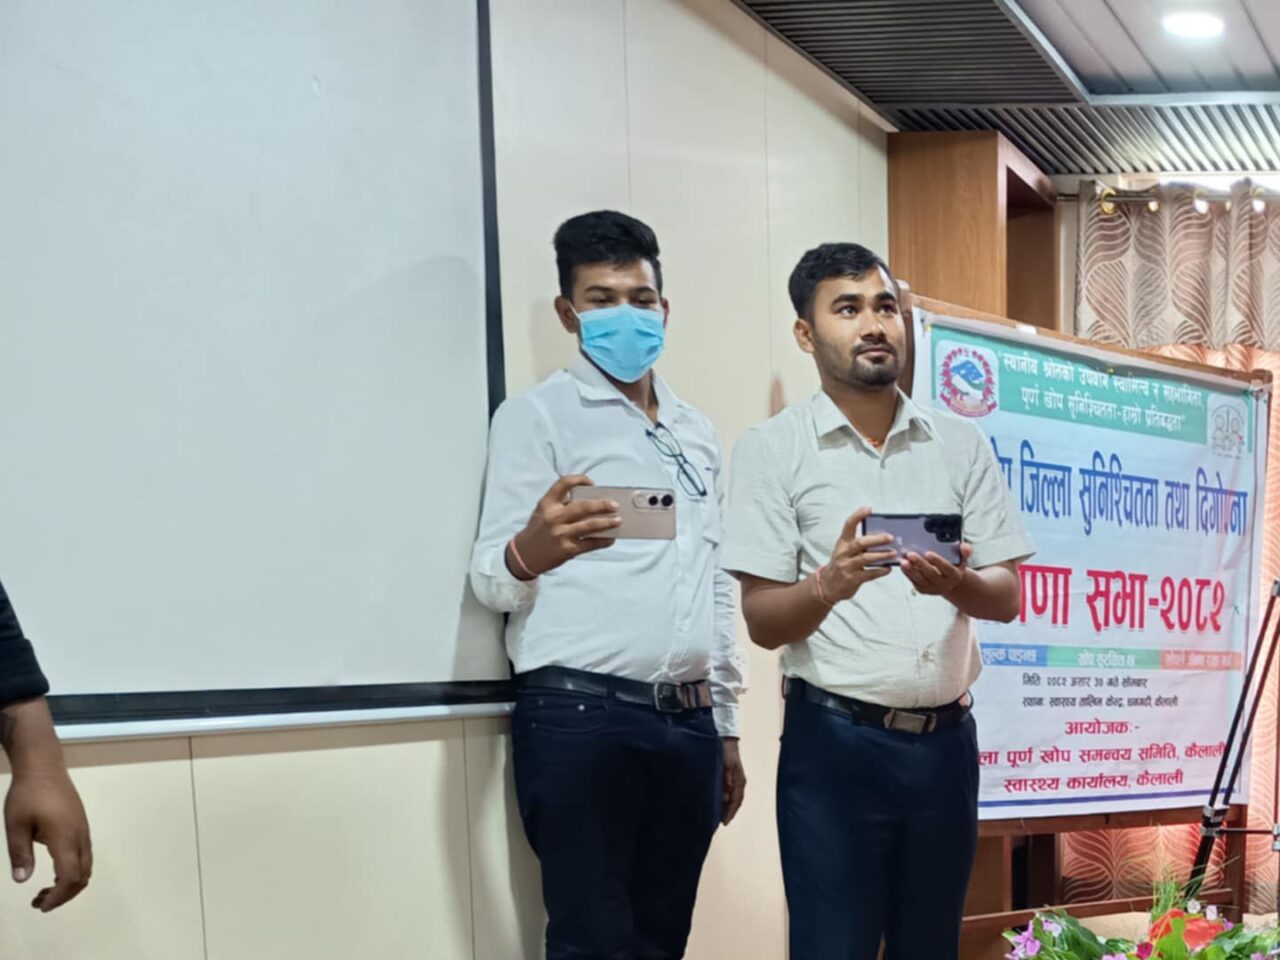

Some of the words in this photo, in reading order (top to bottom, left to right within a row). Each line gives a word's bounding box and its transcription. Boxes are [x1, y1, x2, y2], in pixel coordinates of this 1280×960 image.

[1019, 439, 1072, 519] जिल्ला
[1079, 450, 1159, 536] सुनिश्चितता
[1164, 480, 1190, 530] तथा
[1086, 569, 1225, 632] सभा-२०८२
[1007, 746, 1034, 768] पूर्ण
[1040, 745, 1071, 763] खोप
[1079, 748, 1132, 763] समन्वय
[1136, 768, 1184, 787] कैलाली
